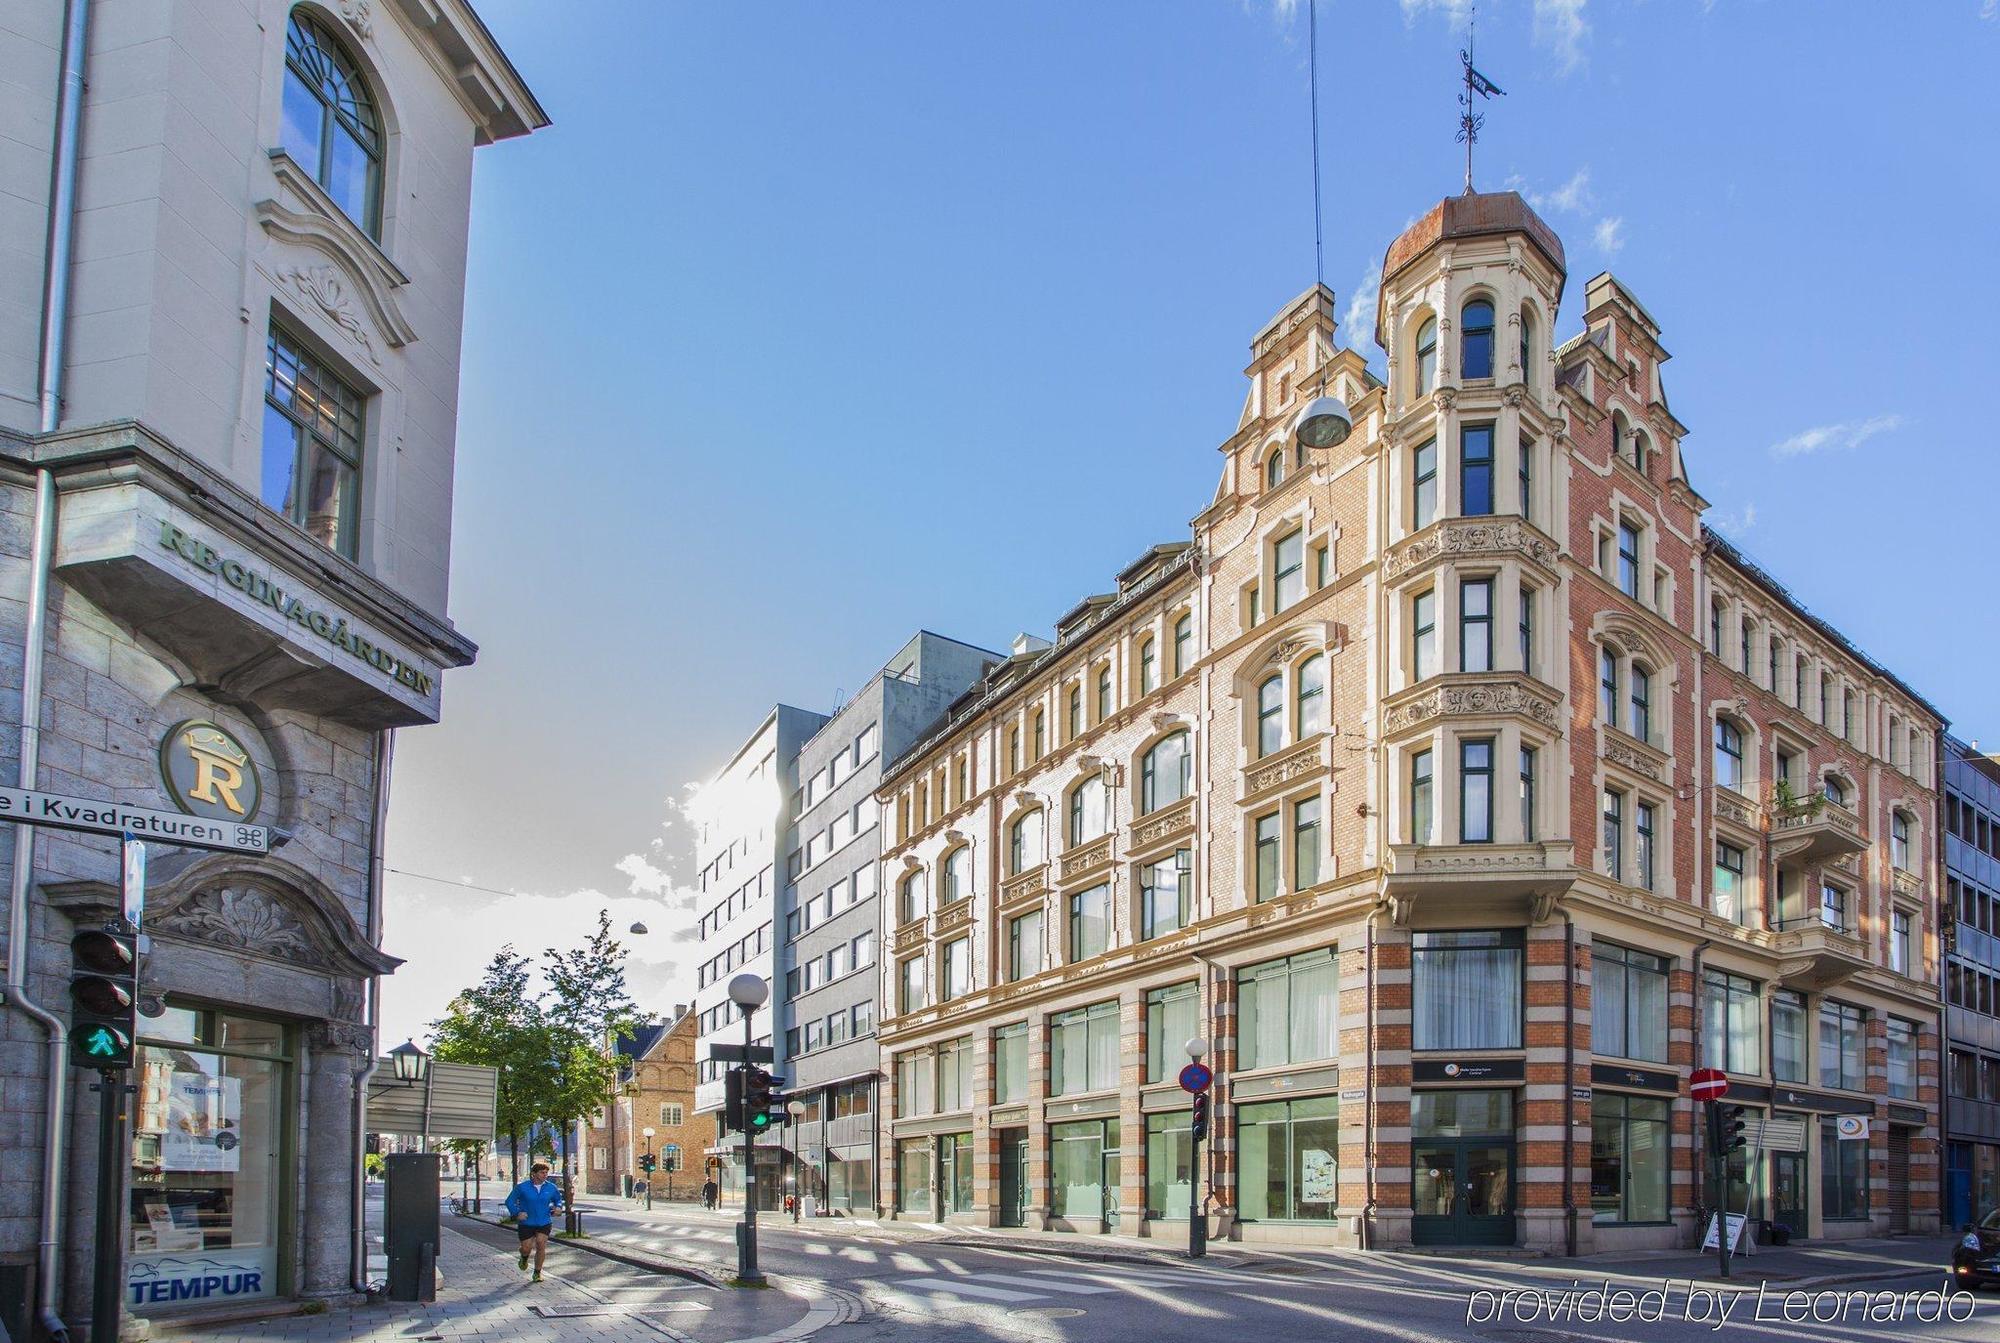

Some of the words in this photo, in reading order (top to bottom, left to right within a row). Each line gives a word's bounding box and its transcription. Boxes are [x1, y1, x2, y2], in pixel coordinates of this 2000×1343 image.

[159, 519, 433, 697] REGINAGÅRDEN
[189, 758, 245, 814] R
[25, 796, 31, 813] i
[43, 798, 223, 841] Kvadraturen
[129, 1273, 262, 1304] TEMPUR
